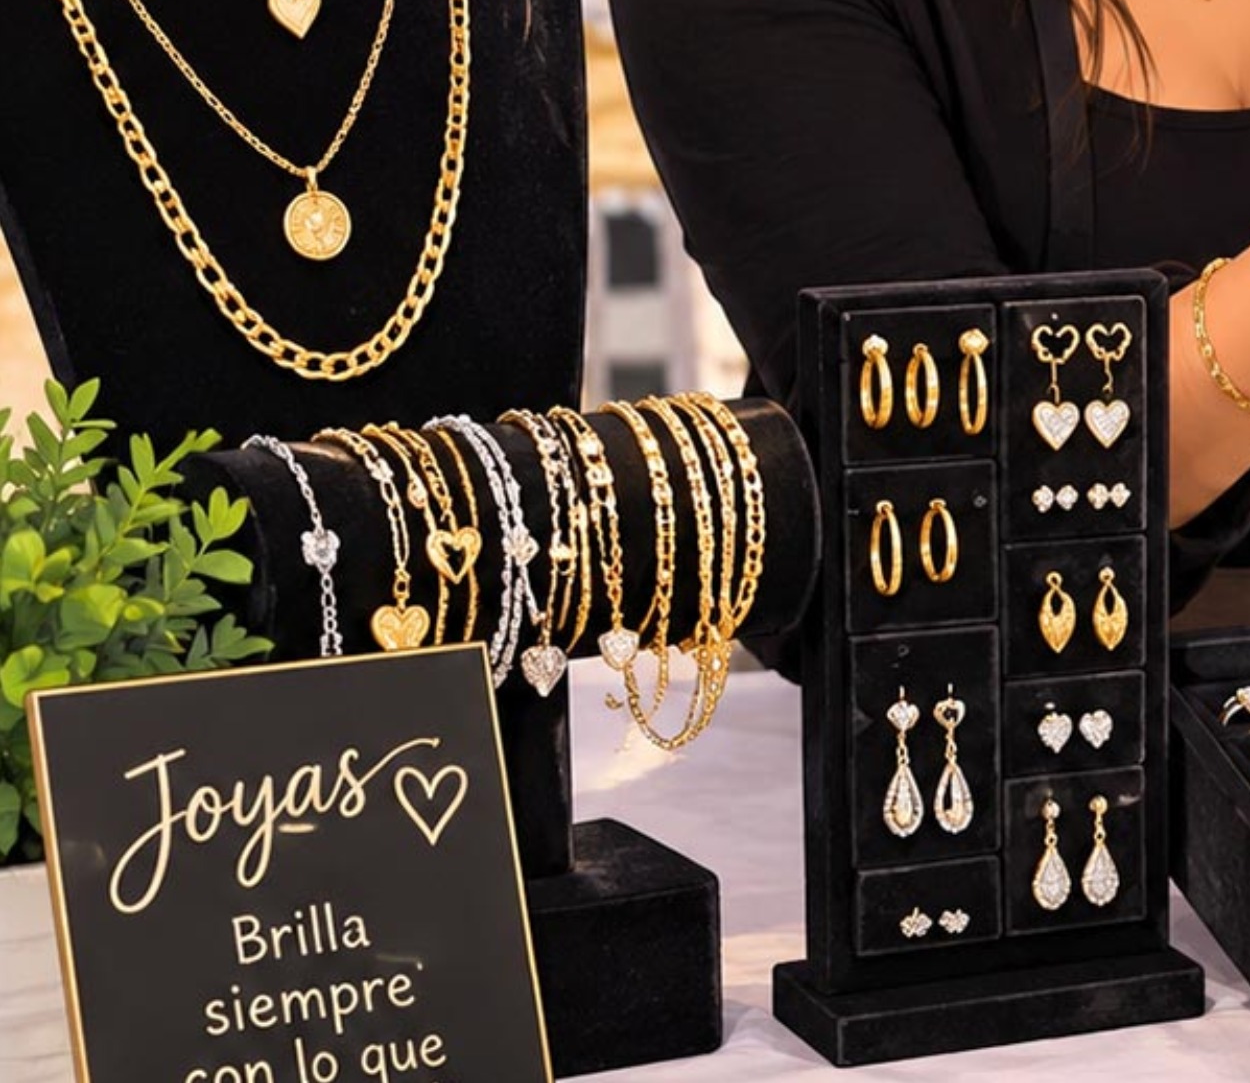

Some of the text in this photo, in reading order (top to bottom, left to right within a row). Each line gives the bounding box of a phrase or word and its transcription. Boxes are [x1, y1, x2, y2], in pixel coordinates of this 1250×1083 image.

[110, 738, 440, 914] Joyas
[231, 902, 371, 965] Brilla
[205, 973, 415, 1036] siempre
[294, 1037, 338, 1083] lo
[360, 1034, 447, 1083] que
